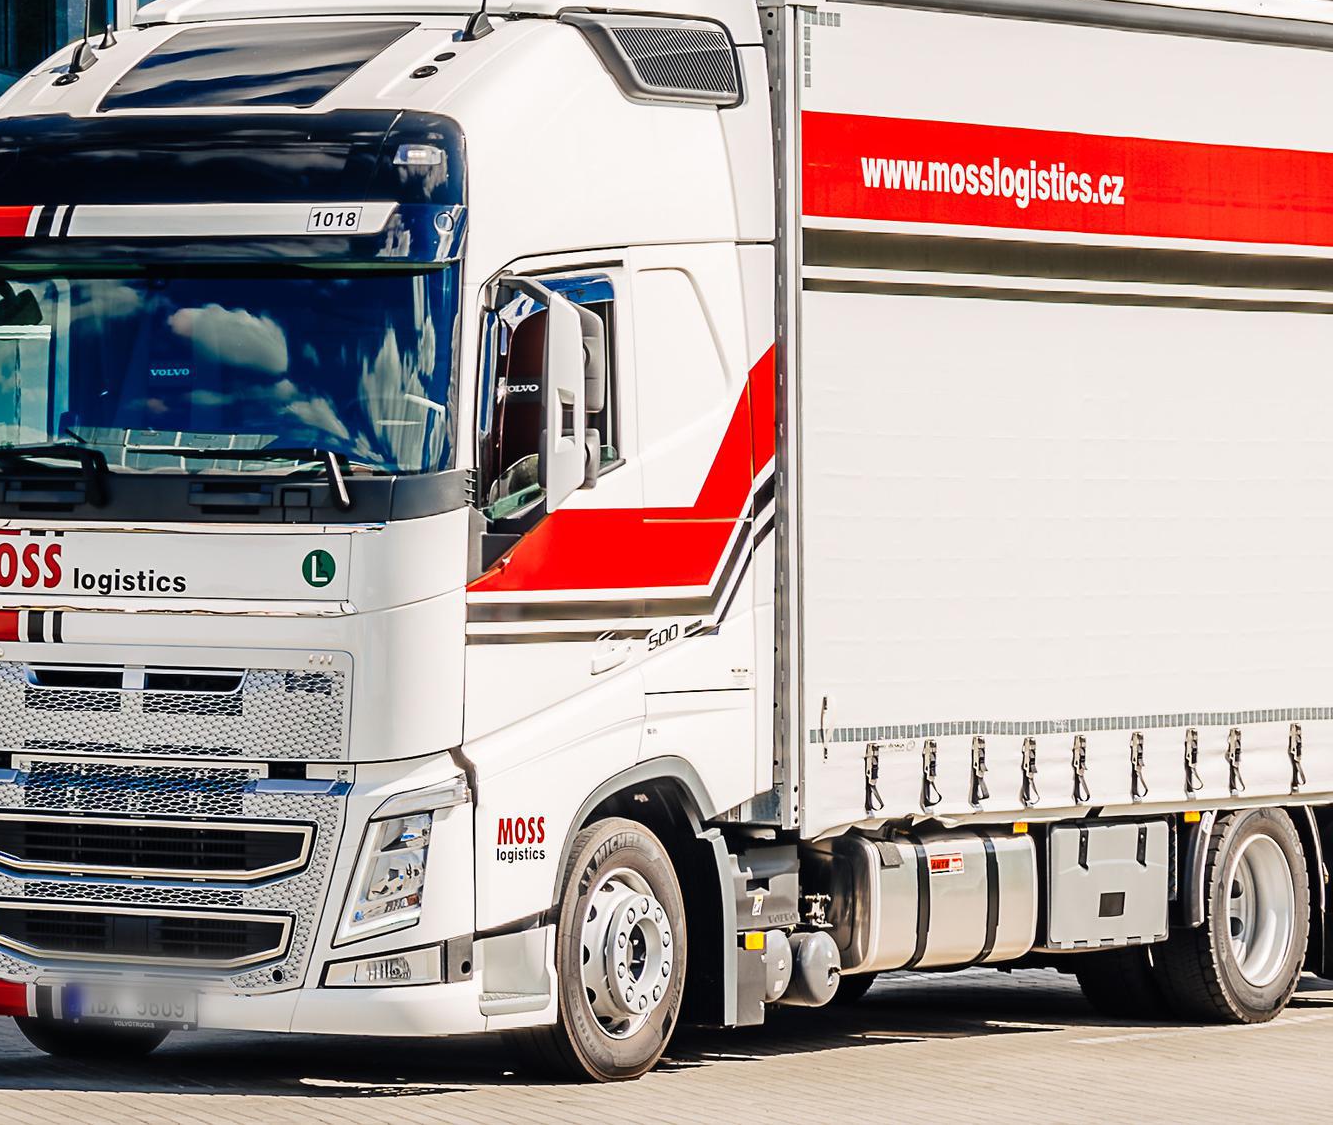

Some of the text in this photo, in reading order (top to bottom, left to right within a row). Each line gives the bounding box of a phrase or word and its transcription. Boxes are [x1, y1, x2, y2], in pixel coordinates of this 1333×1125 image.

[861, 157, 1125, 209] www.mosslogistics.cz
[313, 211, 356, 227] 1018
[150, 368, 190, 376] VOLVO
[505, 384, 539, 393] OLVO
[73, 567, 187, 595] logistics
[312, 555, 328, 582] L
[648, 623, 678, 651] 500
[497, 816, 545, 845] MOSS
[496, 846, 545, 864] logistics
[594, 832, 644, 868] MICHEL
